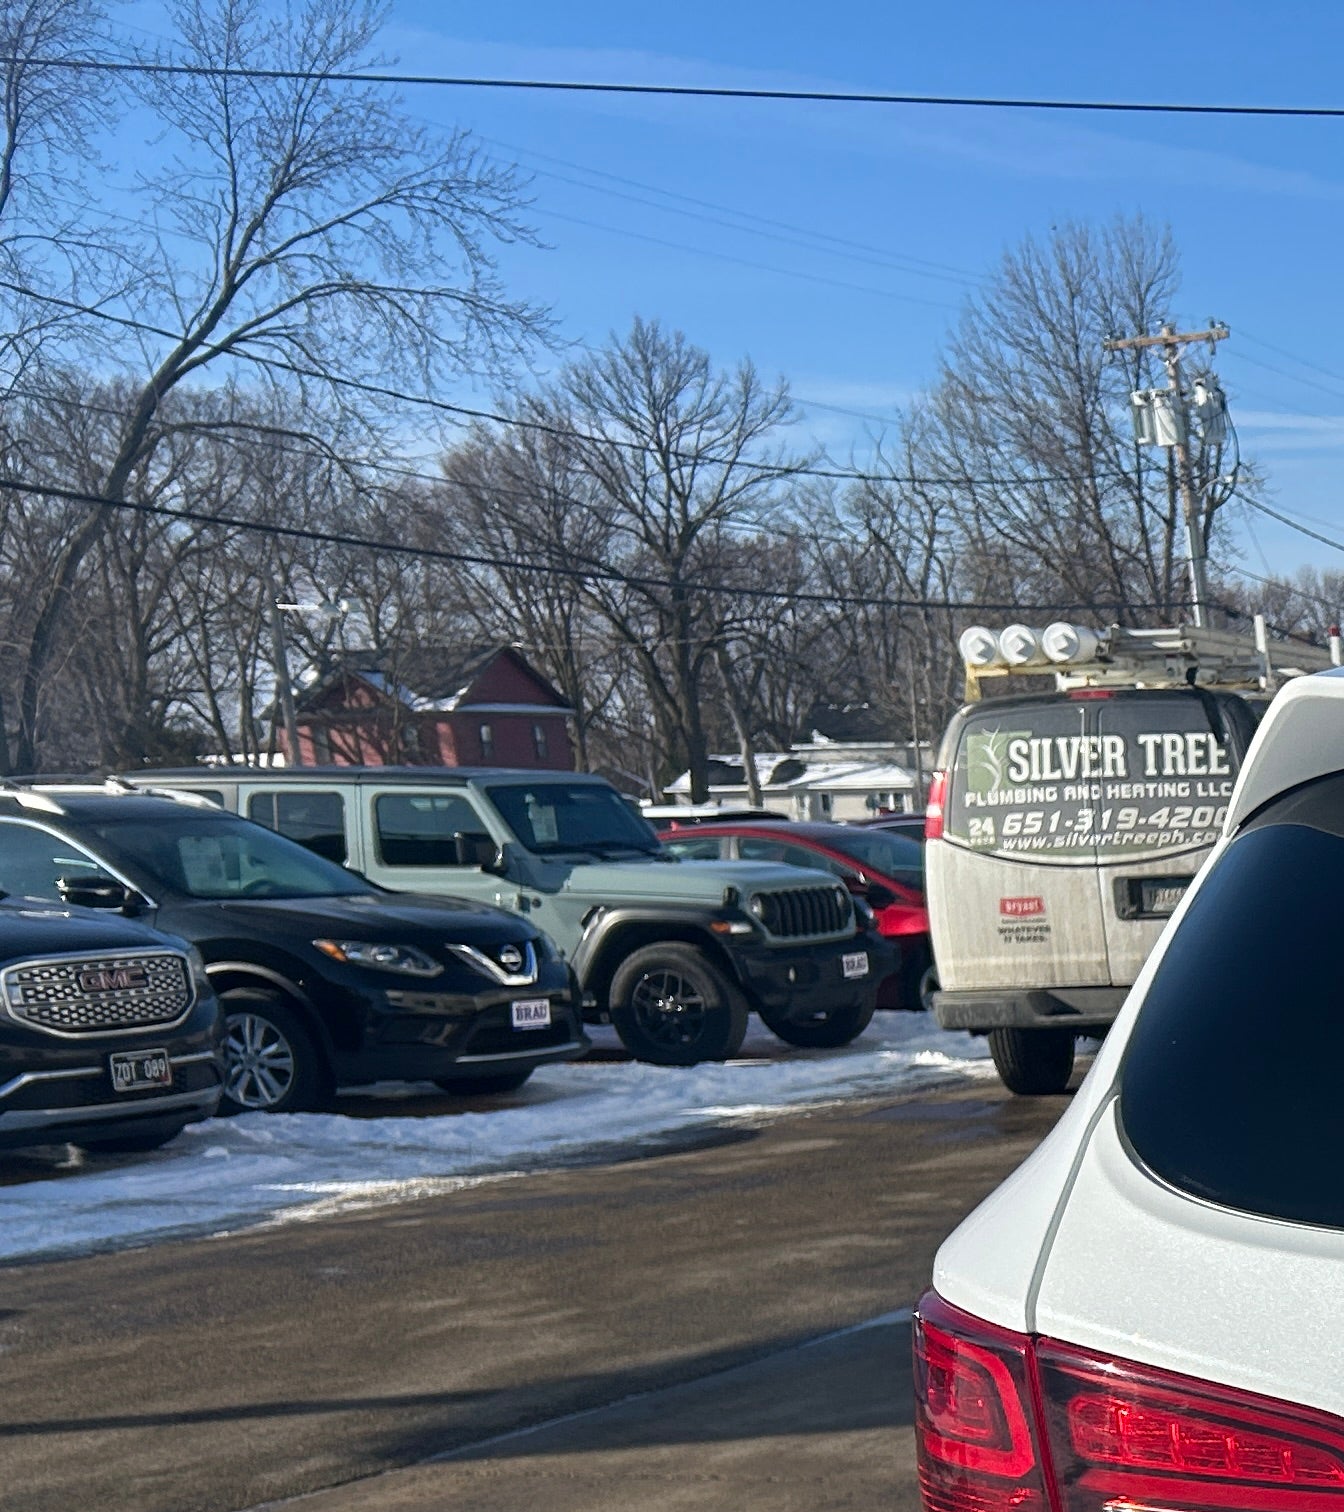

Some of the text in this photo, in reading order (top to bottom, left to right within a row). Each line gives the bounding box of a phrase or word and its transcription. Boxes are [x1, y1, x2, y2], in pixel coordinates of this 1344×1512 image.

[1008, 732, 1230, 783] SILVER TREE
[964, 781, 1233, 808] PLUMBING AND HEATING LLC
[969, 816, 995, 836] 24
[1002, 805, 1228, 837] 651-319-4200
[1002, 829, 1221, 851] www.silvertreeph.co
[80, 969, 147, 992] GMC
